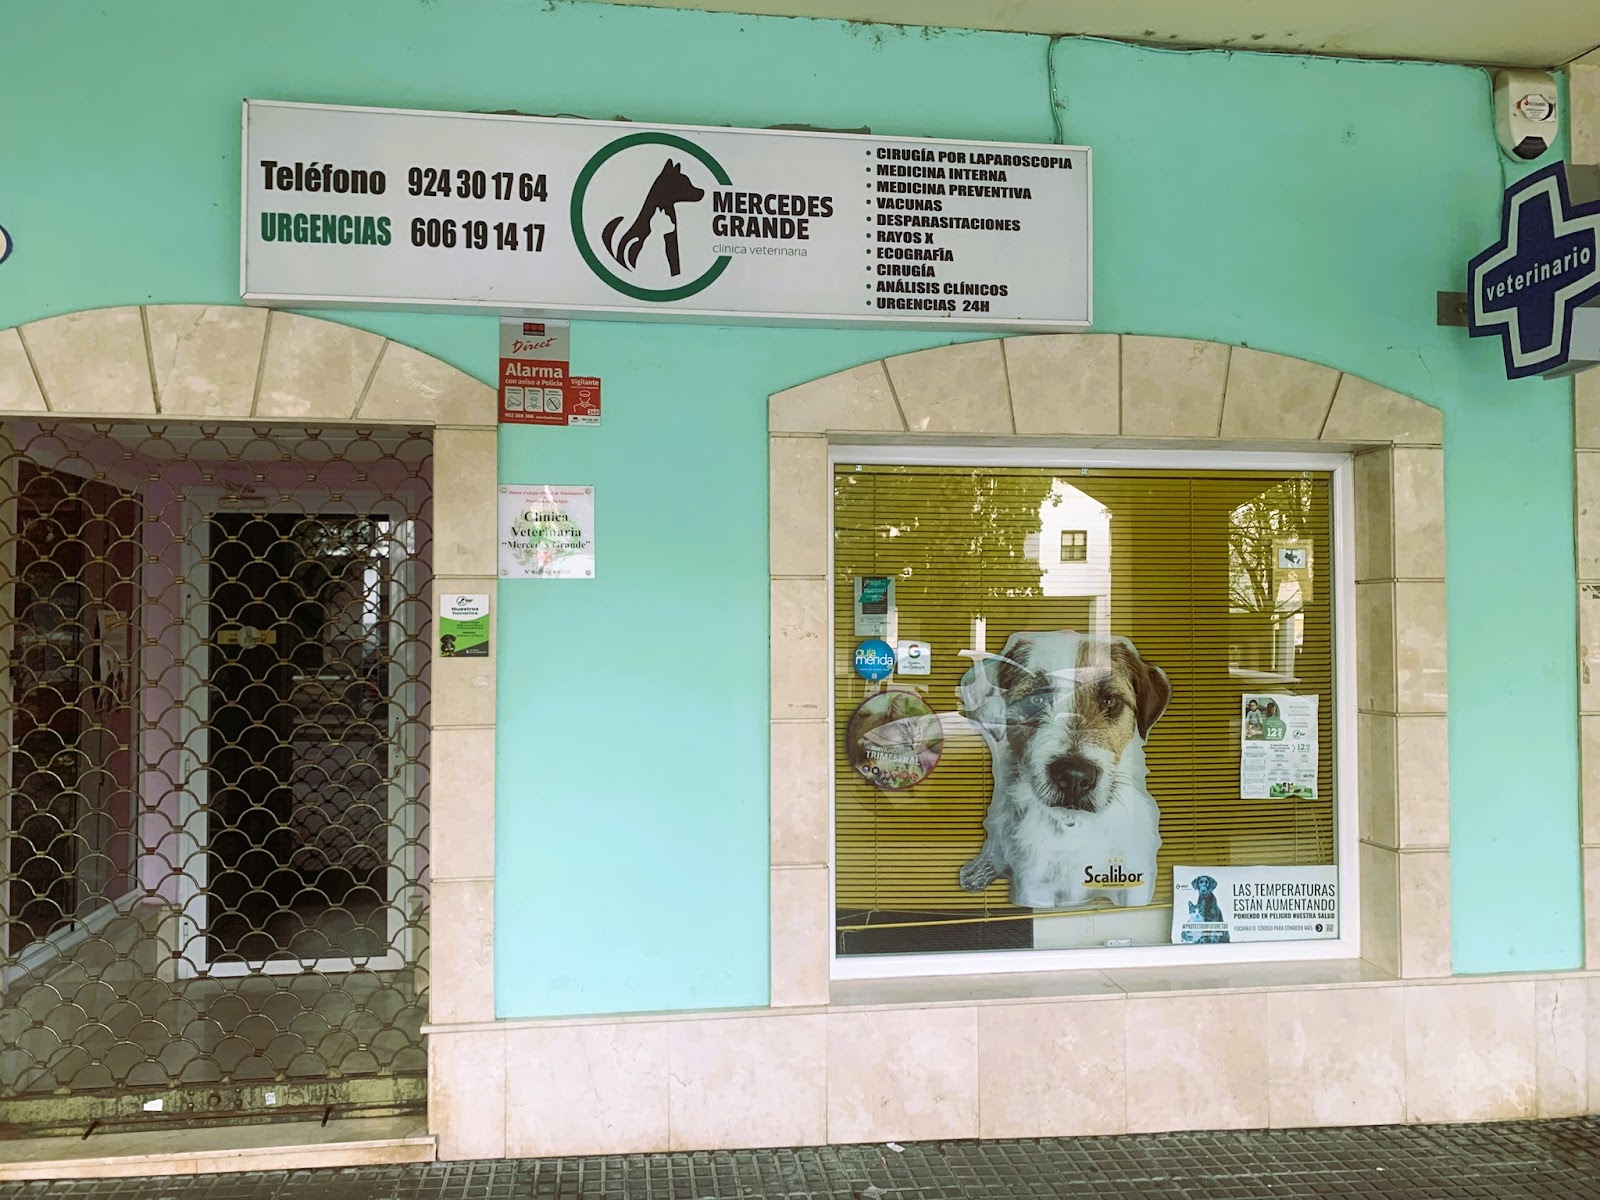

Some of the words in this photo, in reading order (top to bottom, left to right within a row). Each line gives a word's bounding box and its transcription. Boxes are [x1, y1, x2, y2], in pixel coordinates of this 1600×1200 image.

[876, 148, 935, 162] CIRUGÍA
[938, 151, 966, 164] POR
[970, 153, 1072, 169] LAPAROSCOPIA
[260, 160, 386, 194] Teléfono
[408, 168, 450, 197] 924
[456, 170, 486, 199] 30
[492, 172, 514, 200] 17
[519, 173, 548, 202] 64
[876, 164, 946, 179] MEDICINA
[950, 168, 1007, 182] INTERNA
[876, 181, 946, 196] MEDICINA
[950, 184, 1032, 200] PREVENTIVA
[712, 191, 834, 218] MERCEDES
[876, 198, 942, 212] VACUNAS
[712, 215, 810, 240] GRANDE
[877, 214, 1020, 231] DESPARASITACIONES
[261, 212, 392, 246] URGENCIAS
[411, 217, 456, 248] 606
[462, 220, 488, 250] 19
[494, 222, 518, 252] 14
[524, 224, 545, 252] 17
[877, 230, 922, 244] RAYOS
[925, 232, 934, 244] X
[712, 244, 746, 255] clínica
[750, 245, 808, 257] veterinaria
[877, 248, 954, 262] ECOGRAFÍA
[876, 264, 935, 277] CIRUGÍA
[1486, 246, 1590, 301] veterinario
[876, 279, 940, 294] ANÁLISIS
[944, 282, 1008, 296] CLÍNICOS
[876, 298, 956, 312] URGENCIAS
[962, 300, 990, 312] 24H
[511, 338, 558, 354] Direct
[506, 362, 563, 378] Alarma
[511, 526, 581, 537] Veterinaria
[866, 750, 920, 766] TRIMESTRAL
[1084, 866, 1142, 883] Scalibor
[1233, 884, 1250, 897] LAS
[1254, 884, 1335, 897] TEMPERATURAS
[1234, 896, 1263, 911] ESTÁN
[1266, 899, 1335, 911] AUMENTANDO
